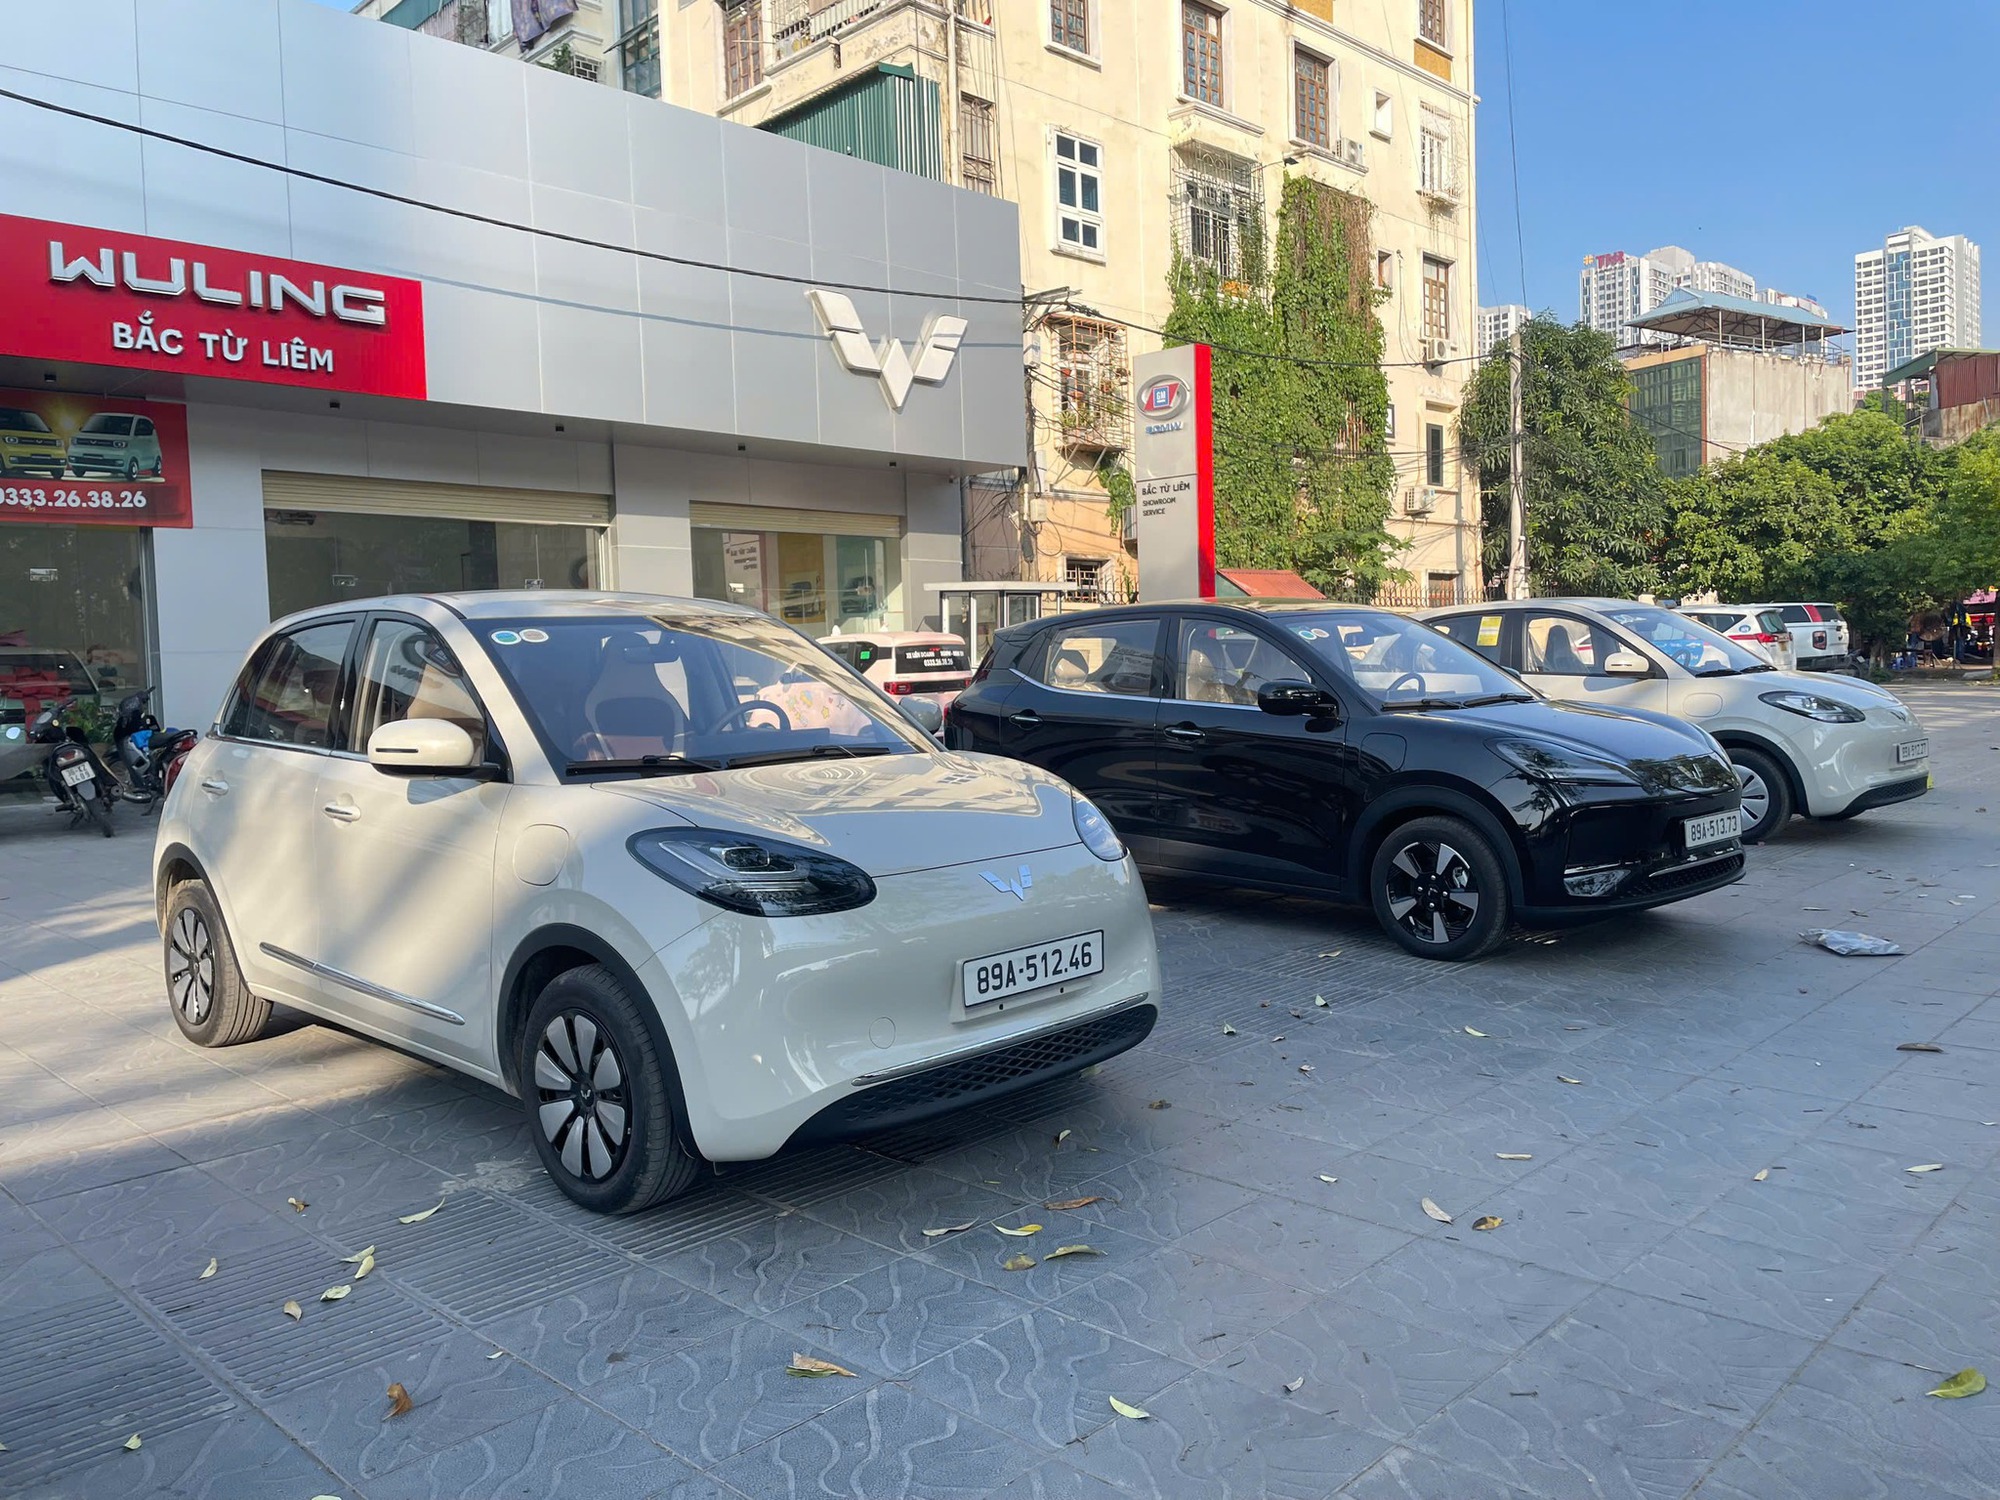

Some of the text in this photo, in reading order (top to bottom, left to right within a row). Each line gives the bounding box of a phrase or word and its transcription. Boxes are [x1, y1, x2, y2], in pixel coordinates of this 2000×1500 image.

[49, 240, 387, 326] WULING
[112, 310, 334, 373] BẮC TỪ LIÊM
[1156, 390, 1166, 400] GM
[1142, 480, 1191, 496] BẮC TỪ LIÊM
[1142, 496, 1176, 507] SHOWROOM
[1142, 507, 1166, 517] SERVICE
[1690, 815, 1738, 842] 89A-513.73
[976, 941, 1092, 995] 89A-512.46
